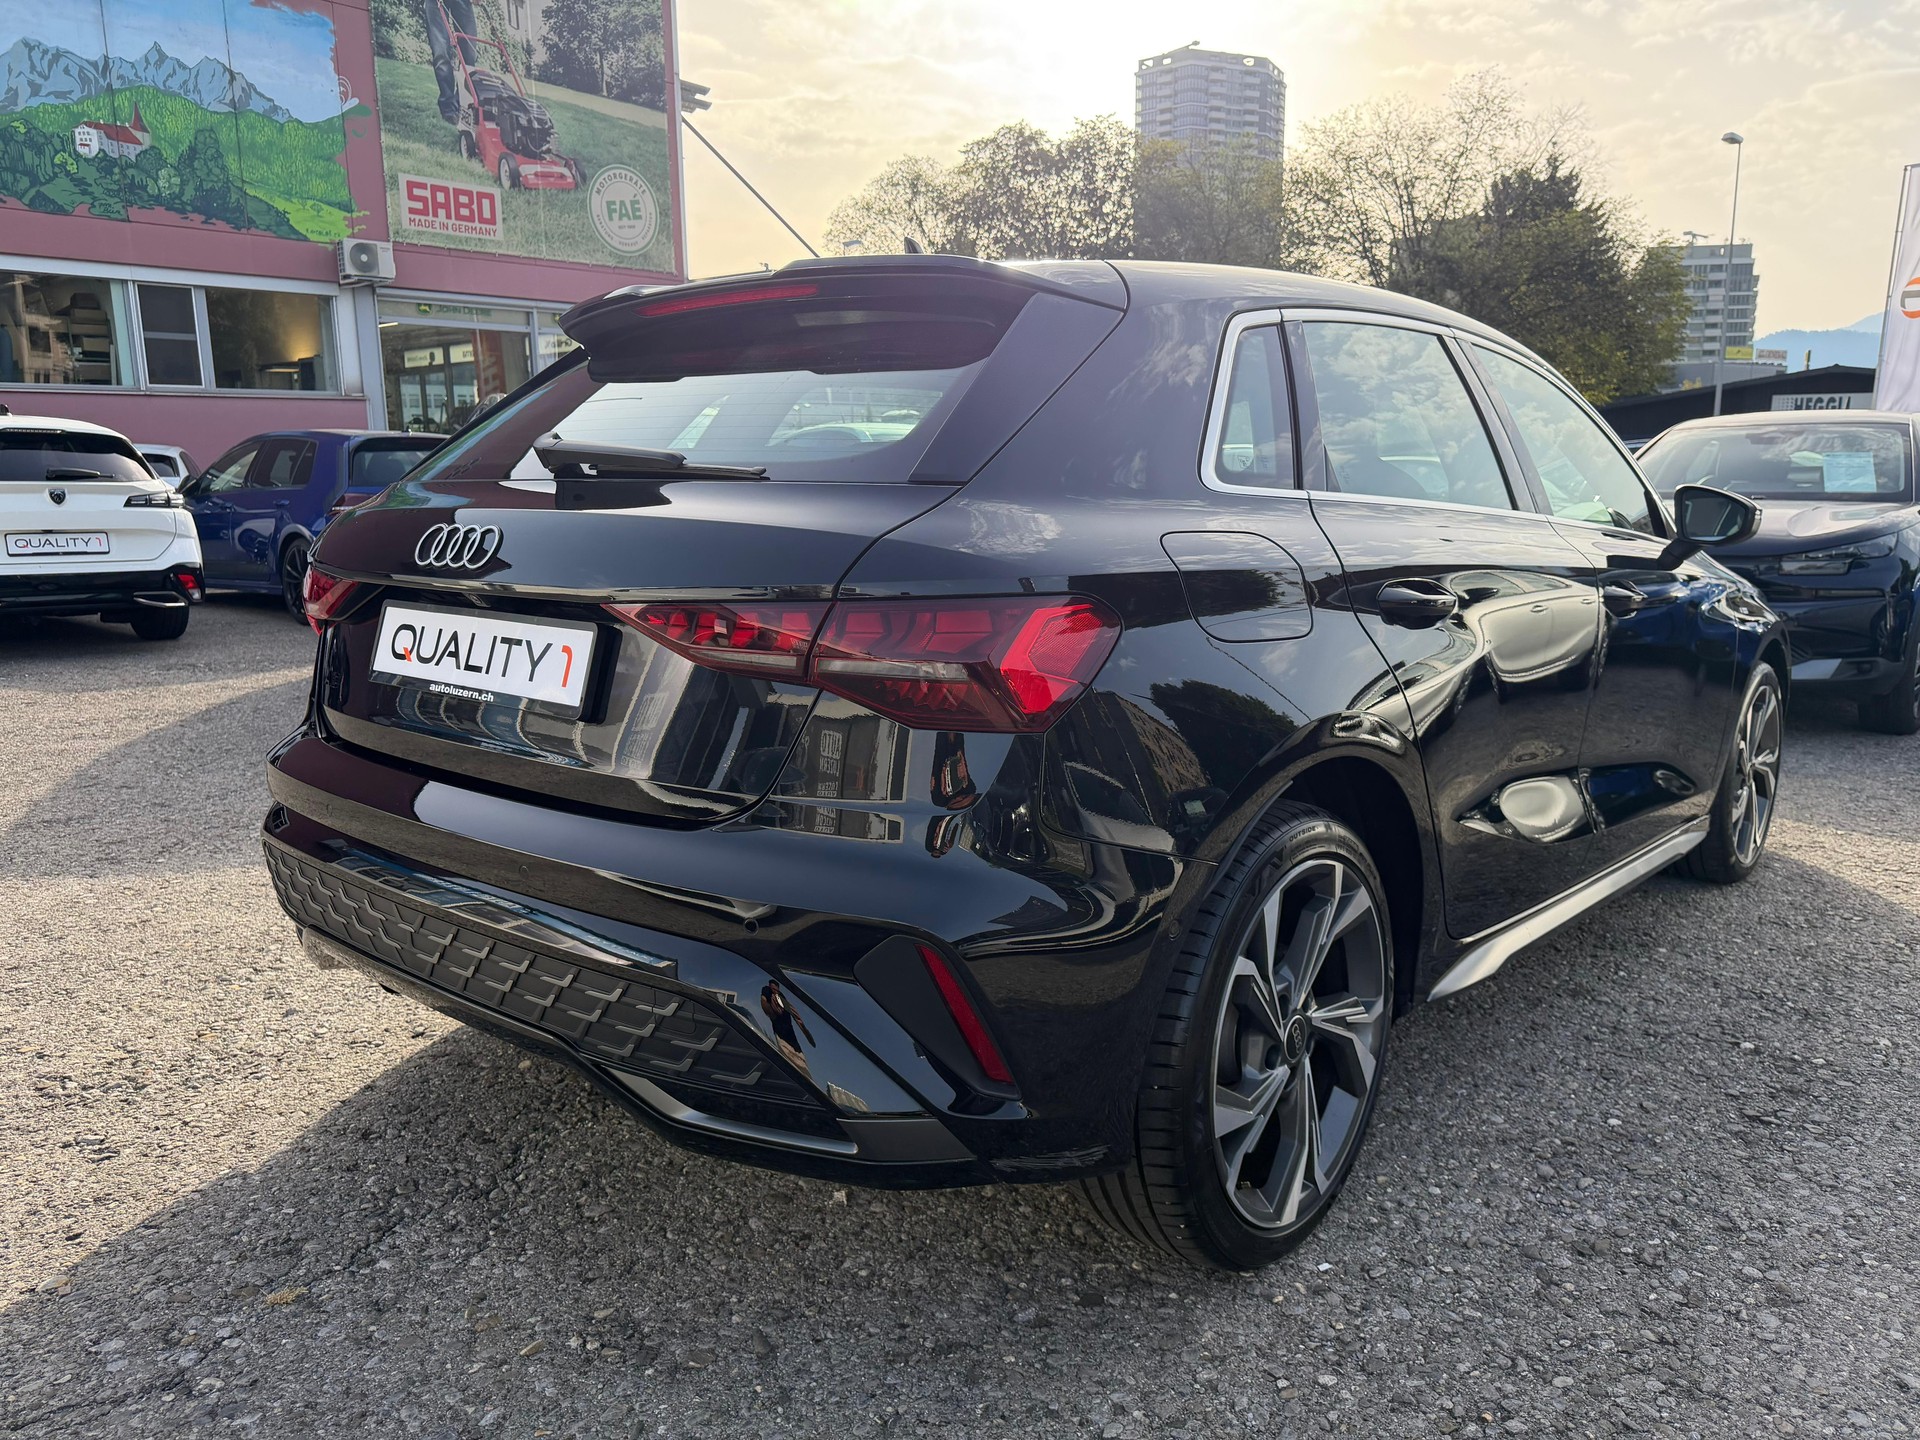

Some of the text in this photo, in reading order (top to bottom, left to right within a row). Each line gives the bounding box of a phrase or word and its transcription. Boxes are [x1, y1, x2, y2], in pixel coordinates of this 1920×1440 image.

[406, 180, 497, 226] SABO
[606, 193, 642, 221] FAÉ
[409, 217, 497, 237] MADE IN GERMANY
[14, 537, 102, 548] QUALITY 1
[391, 624, 573, 688] QUALITY 1
[429, 682, 494, 702] autoluzern.ch
[1289, 826, 1316, 842] OUTSIDE
